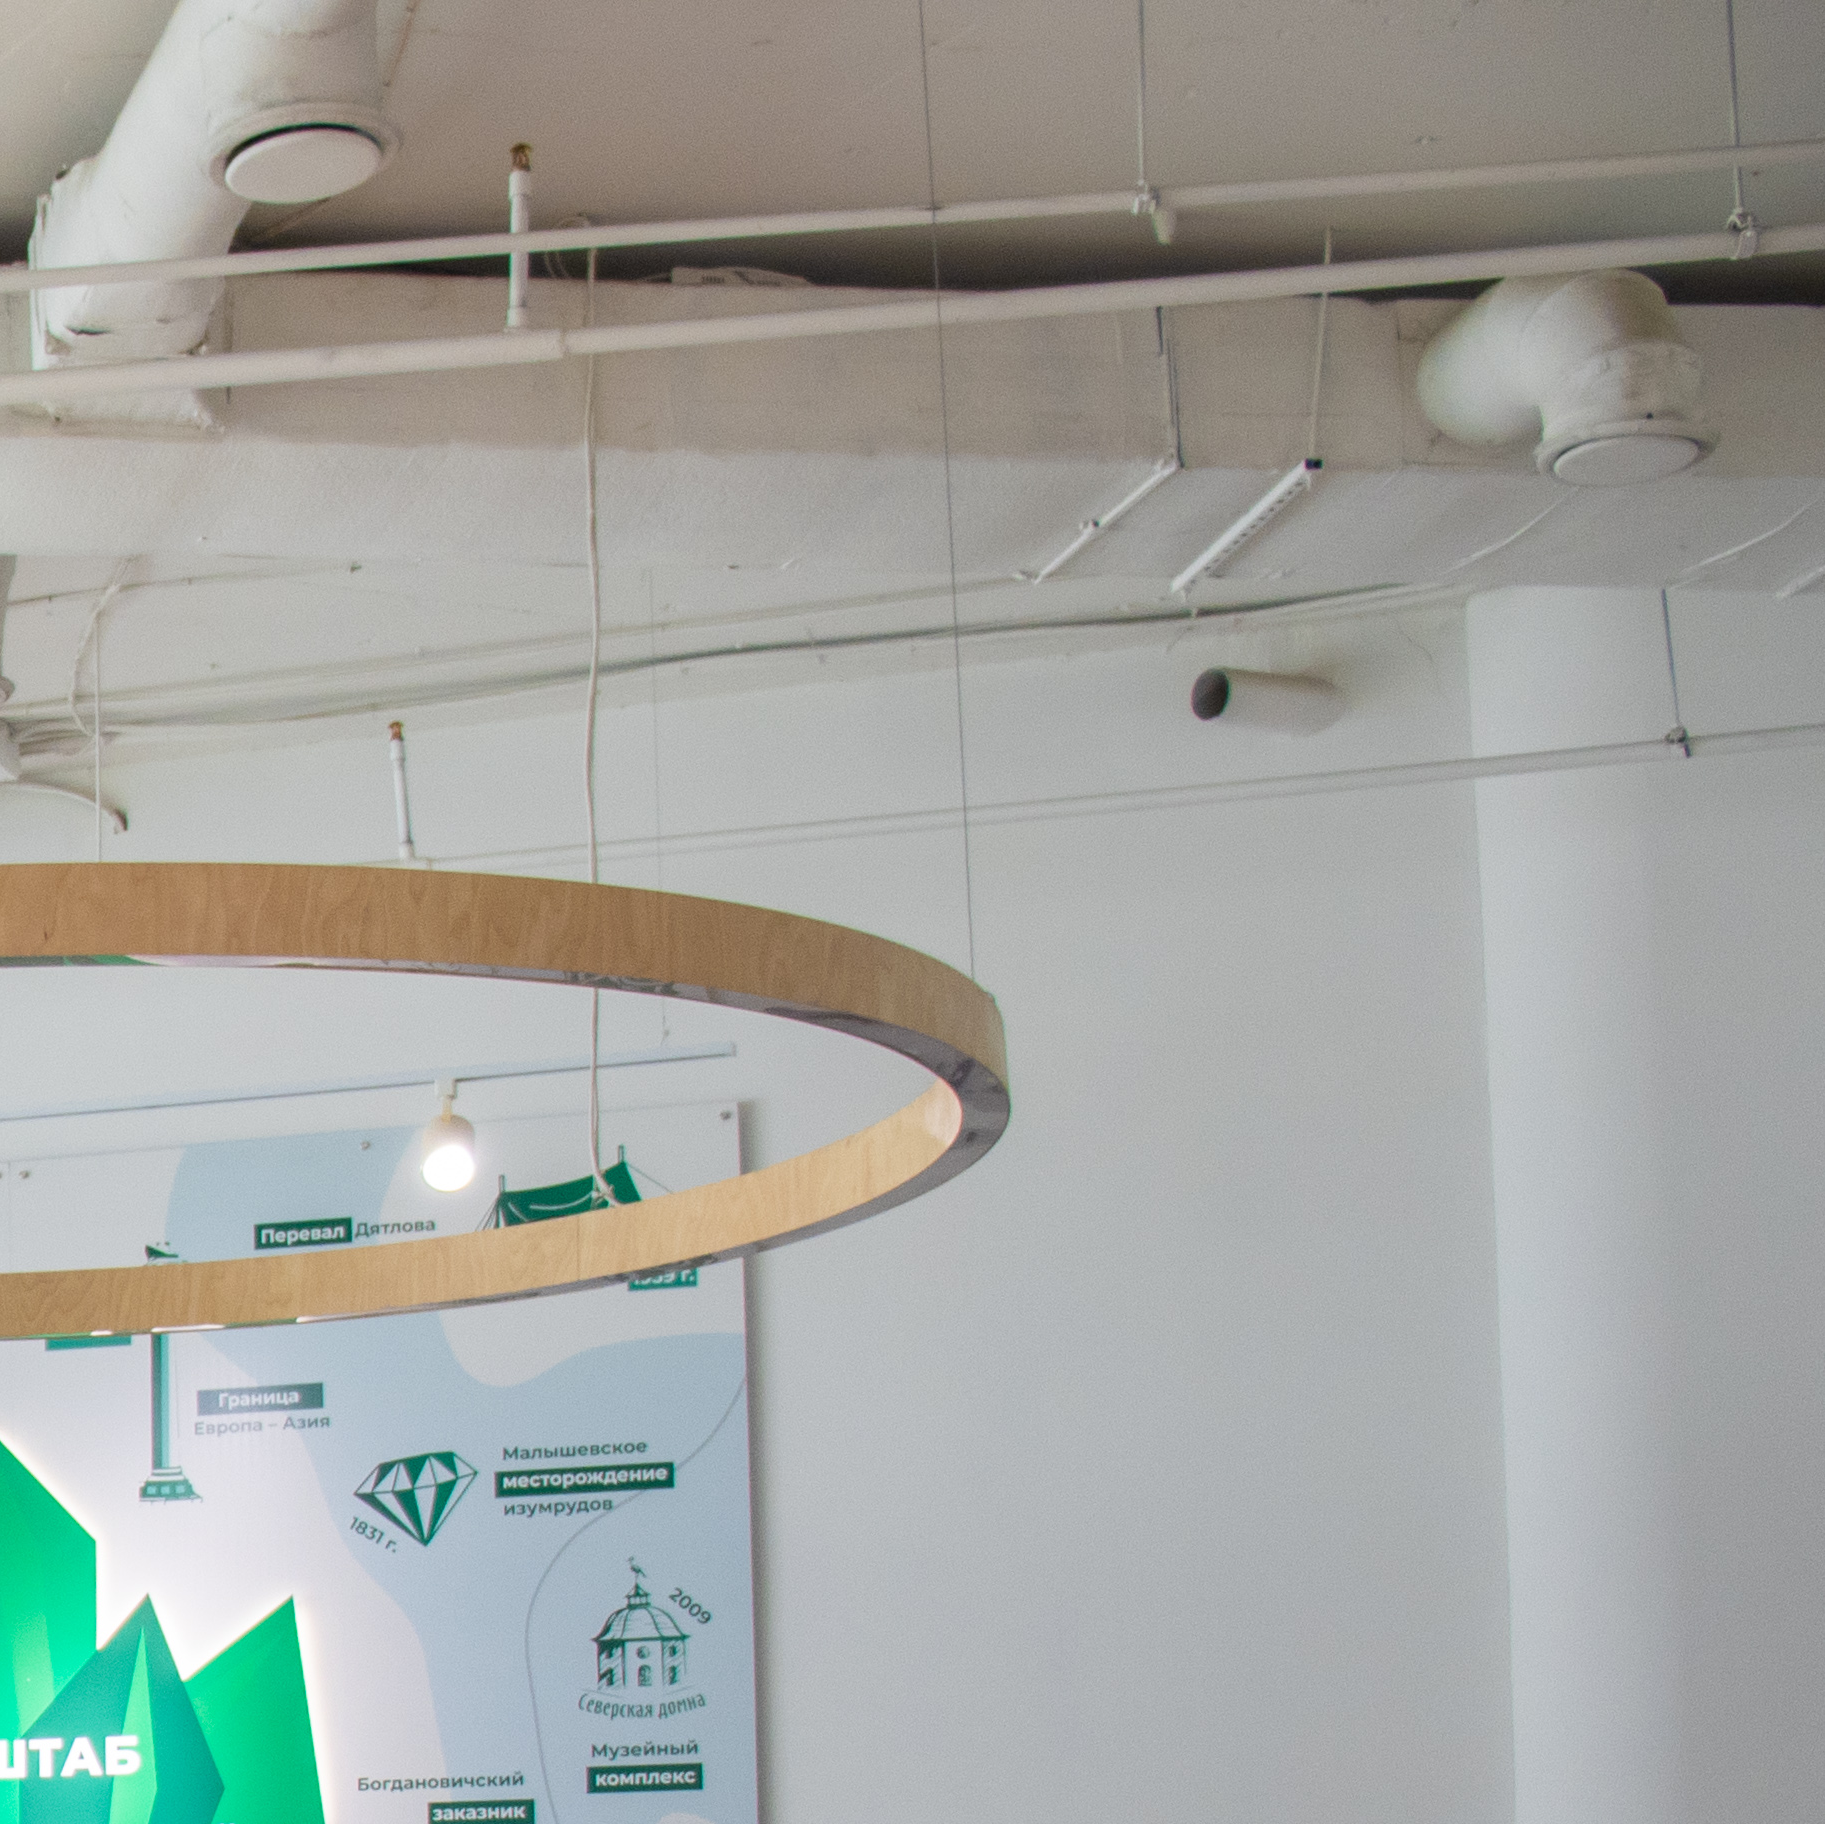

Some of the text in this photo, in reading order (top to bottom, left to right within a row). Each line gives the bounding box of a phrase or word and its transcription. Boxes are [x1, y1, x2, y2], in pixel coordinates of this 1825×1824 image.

[260, 1219, 436, 1246] Перевал Дятлова
[218, 1391, 302, 1411] Граница
[194, 1421, 263, 1437] Европа
[282, 1416, 330, 1430] Азия
[502, 1440, 649, 1461] Малышевское
[502, 1467, 669, 1491] месторождение
[503, 1499, 614, 1517] изумрудов
[349, 1516, 398, 1553] 1831 г.
[668, 1587, 712, 1625] 2009
[578, 1692, 707, 1720] Северская домна
[591, 1739, 700, 1761] Музейный
[357, 1771, 525, 1792] Богдановичский
[595, 1769, 698, 1787] комплекс
[432, 1804, 527, 1822] заказник
